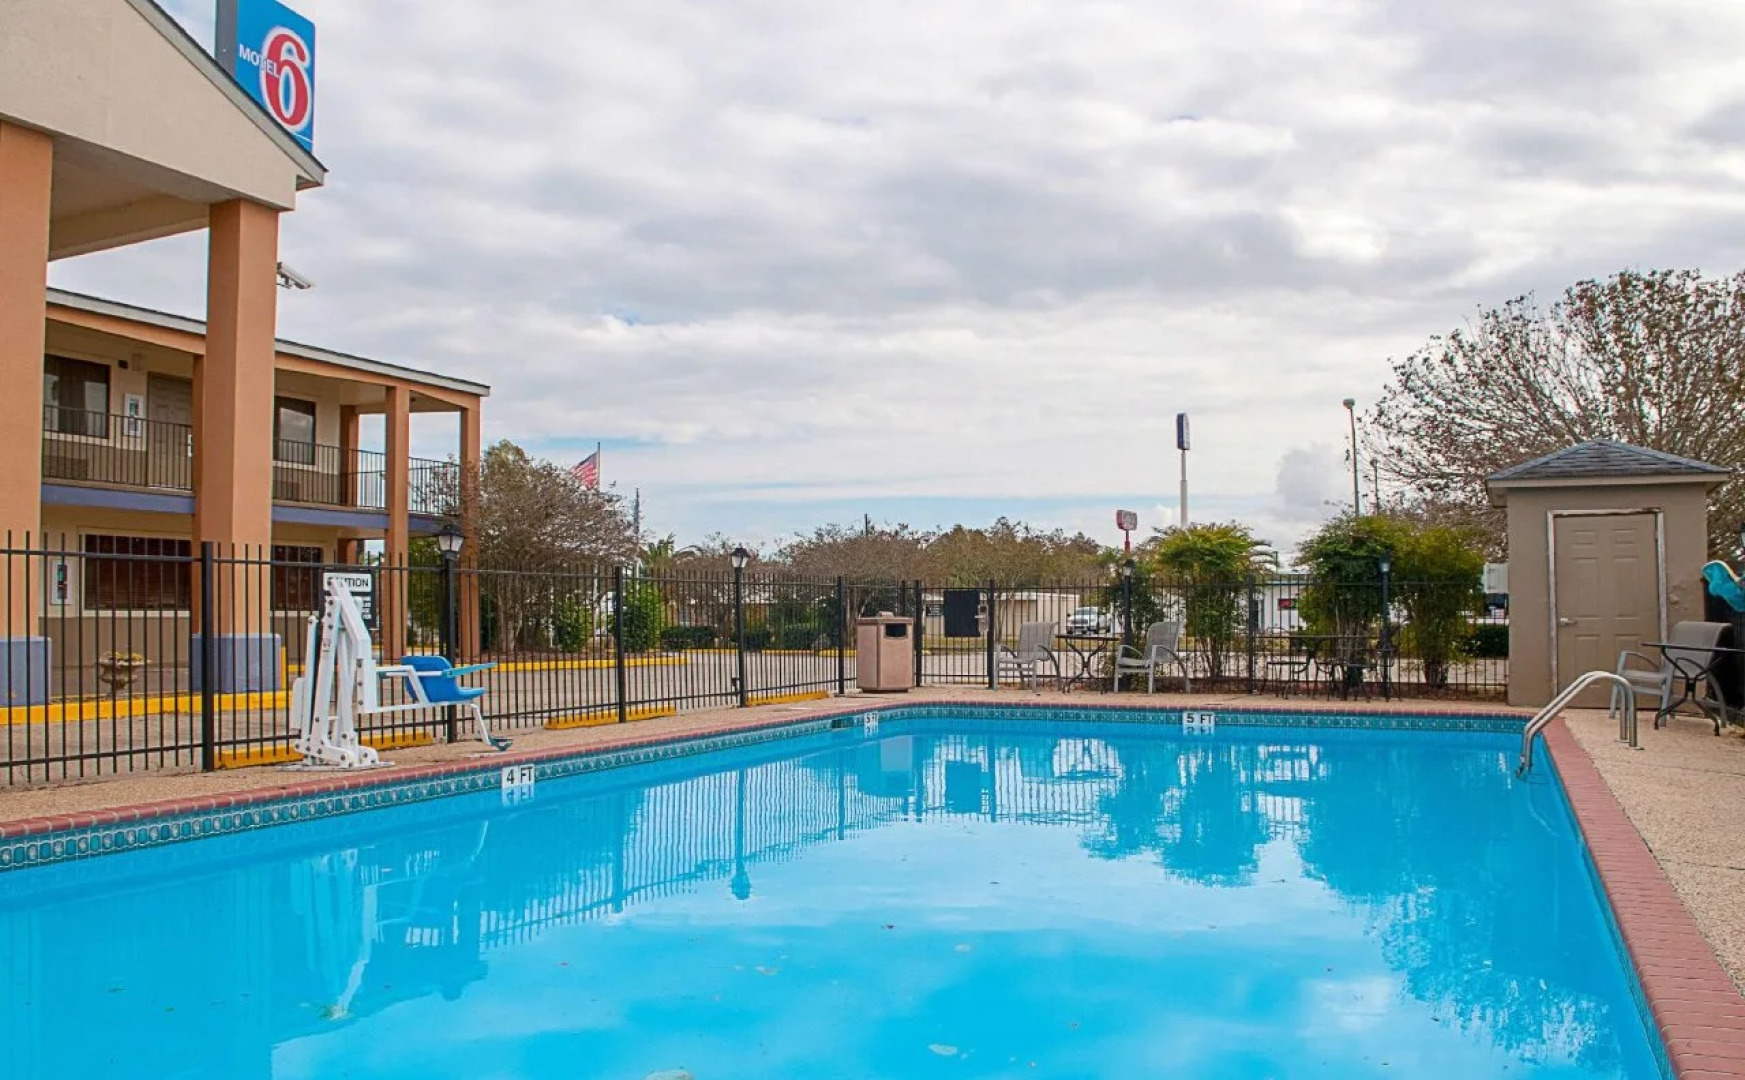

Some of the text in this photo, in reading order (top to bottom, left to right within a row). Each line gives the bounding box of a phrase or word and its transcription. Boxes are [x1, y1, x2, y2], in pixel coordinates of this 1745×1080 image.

[239, 27, 311, 131] MOTEL 6
[327, 576, 369, 587] TION
[1186, 712, 1212, 725] 5 FT
[506, 765, 533, 785] 4 FT
